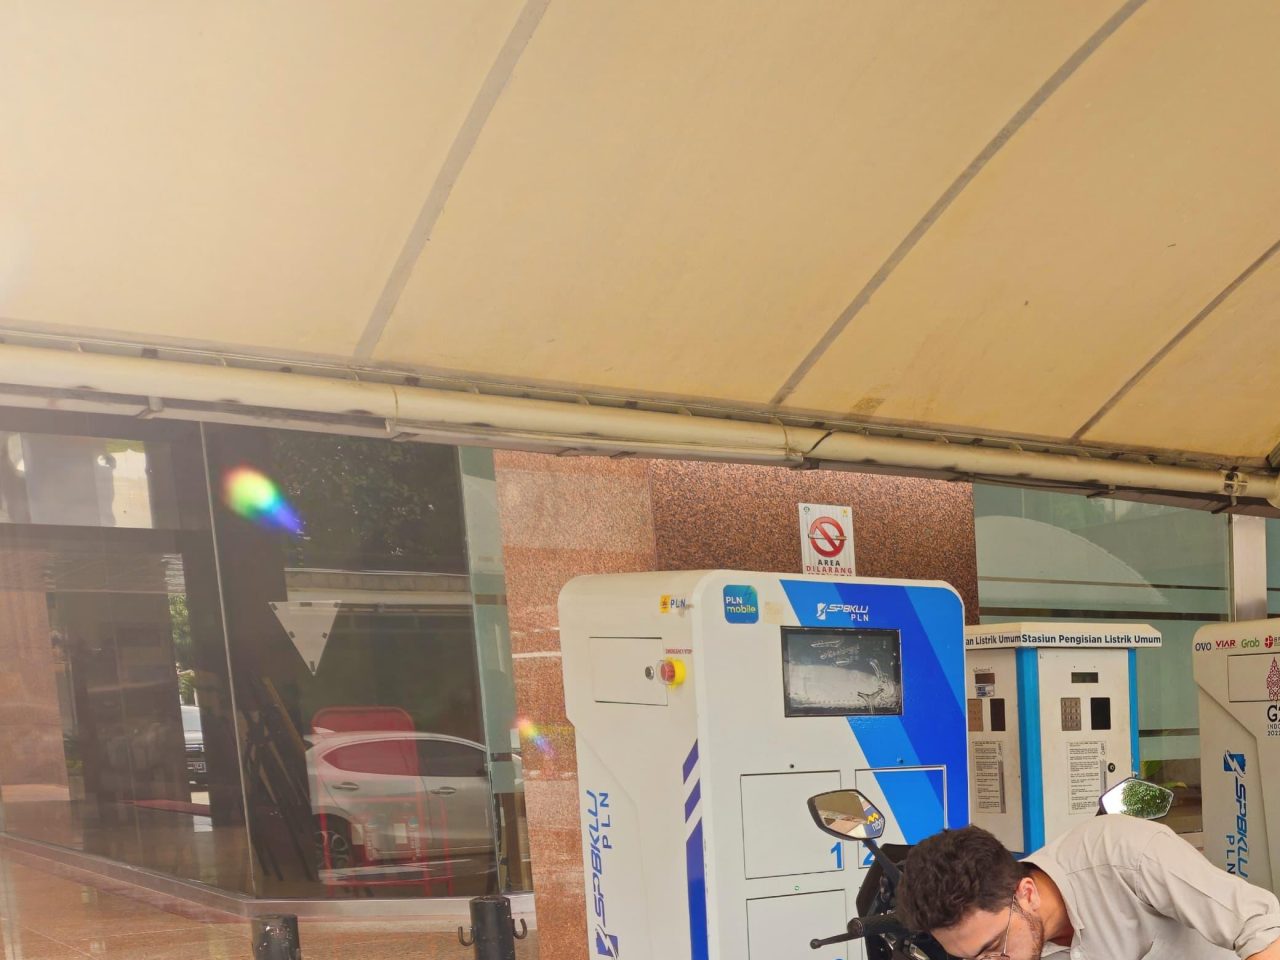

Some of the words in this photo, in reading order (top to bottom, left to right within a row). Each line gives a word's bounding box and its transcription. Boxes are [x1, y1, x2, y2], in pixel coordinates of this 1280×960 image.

[818, 559, 840, 567] AREA
[806, 565, 853, 574] DILARANG
[670, 599, 686, 608] PLN
[725, 596, 743, 604] PLN
[726, 604, 756, 613] mobile
[851, 613, 869, 621] PLN
[976, 635, 997, 645] Listrik
[998, 635, 1021, 644] Umum
[1022, 634, 1056, 643] Stasiun
[1059, 634, 1102, 645] Pengisian
[1105, 634, 1132, 644] Listrik
[1134, 635, 1161, 644] Umum
[1215, 639, 1236, 648] VIAR
[1195, 642, 1212, 651] OVO
[599, 792, 613, 850] PLN
[830, 841, 843, 869] 1
[1226, 834, 1236, 874] PLN
